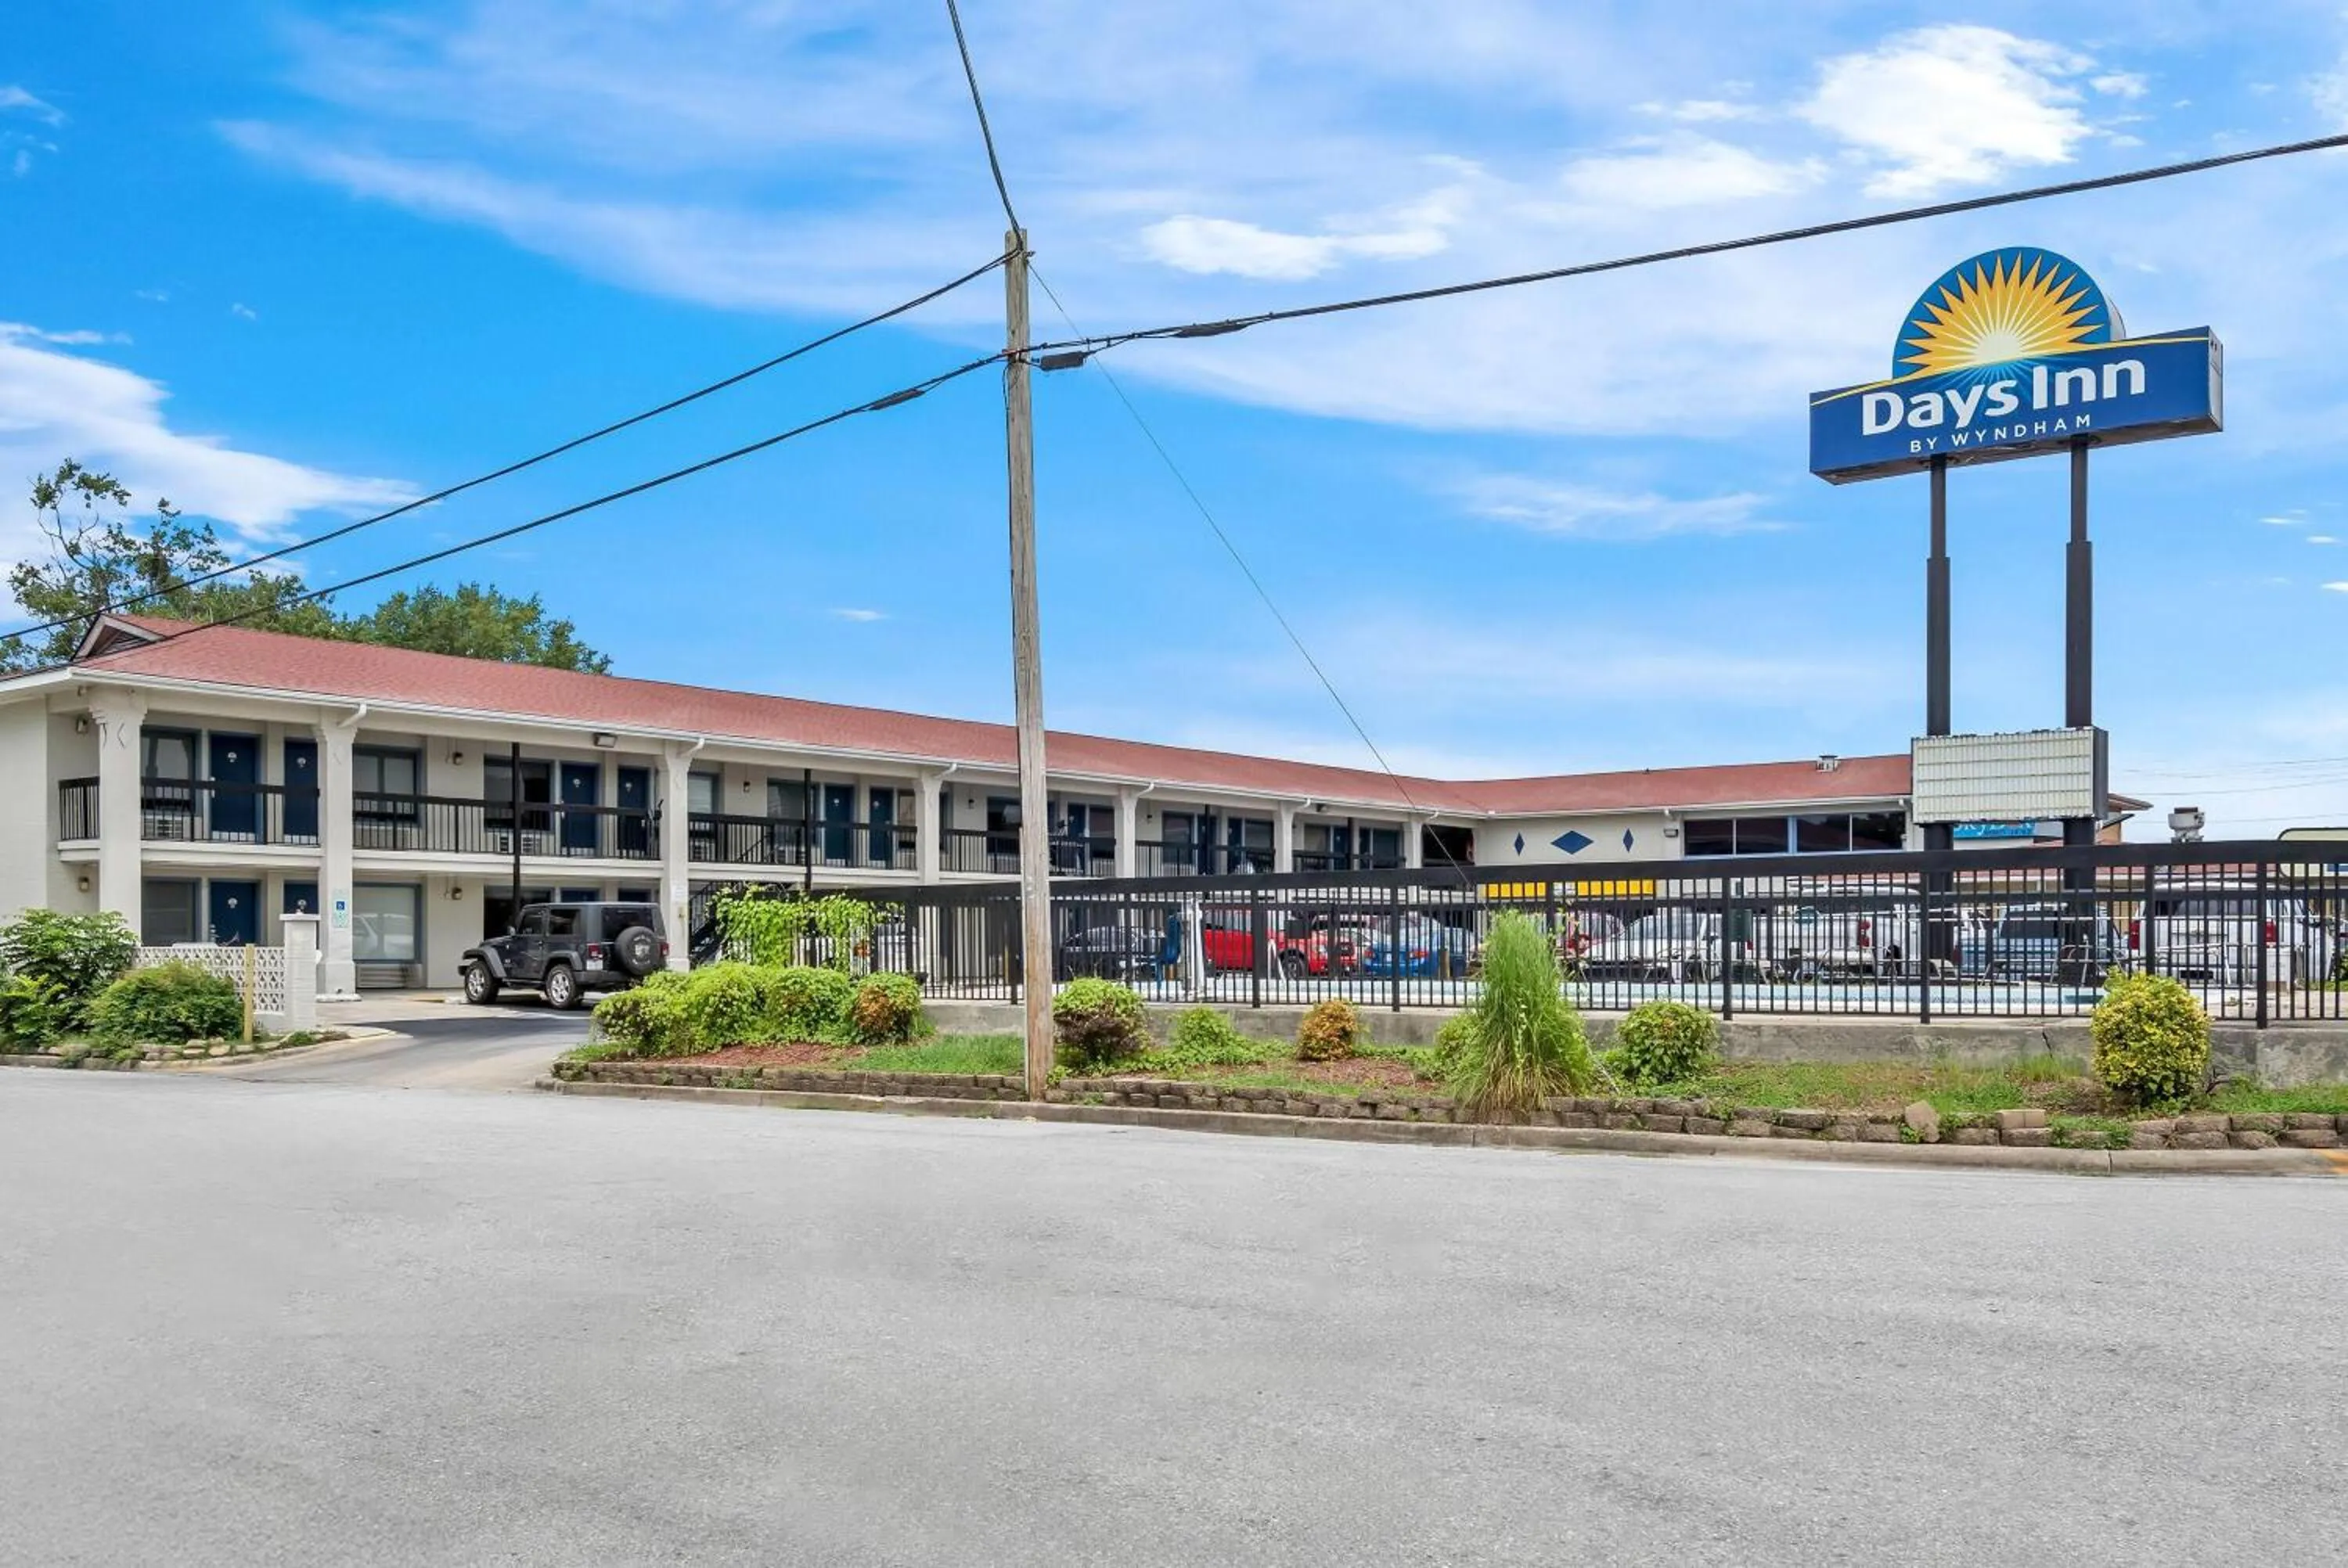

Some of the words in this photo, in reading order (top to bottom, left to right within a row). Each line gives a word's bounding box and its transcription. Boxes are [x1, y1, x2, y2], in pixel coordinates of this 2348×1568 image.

[1862, 379, 2018, 435] Days
[2033, 359, 2145, 410] Inn
[1910, 437, 1938, 453] BY
[1952, 414, 2091, 447] WYNDHAM
